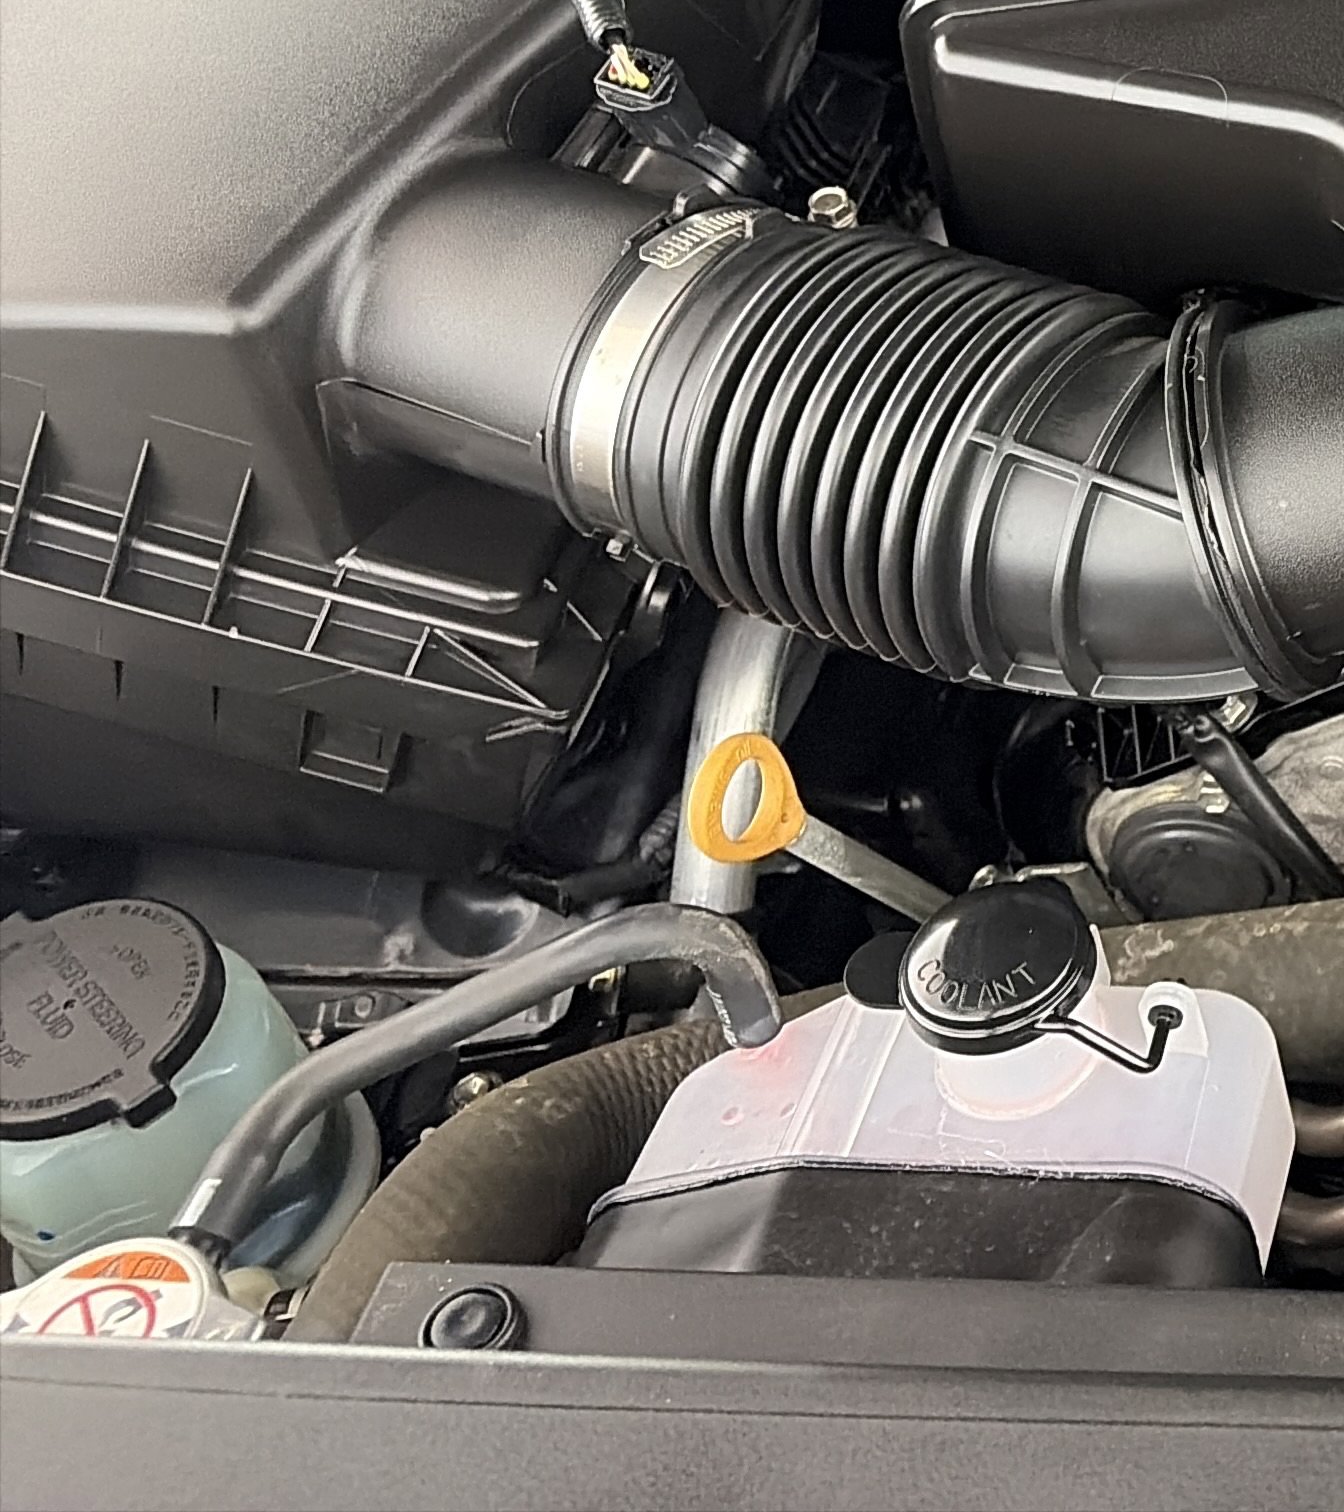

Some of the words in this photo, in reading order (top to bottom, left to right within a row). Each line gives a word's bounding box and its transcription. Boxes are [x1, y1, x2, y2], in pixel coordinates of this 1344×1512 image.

[36, 929, 89, 989] POWER
[74, 979, 147, 1061] STEERING
[916, 960, 1037, 1011] COOLANT
[26, 990, 75, 1040] FLUID
